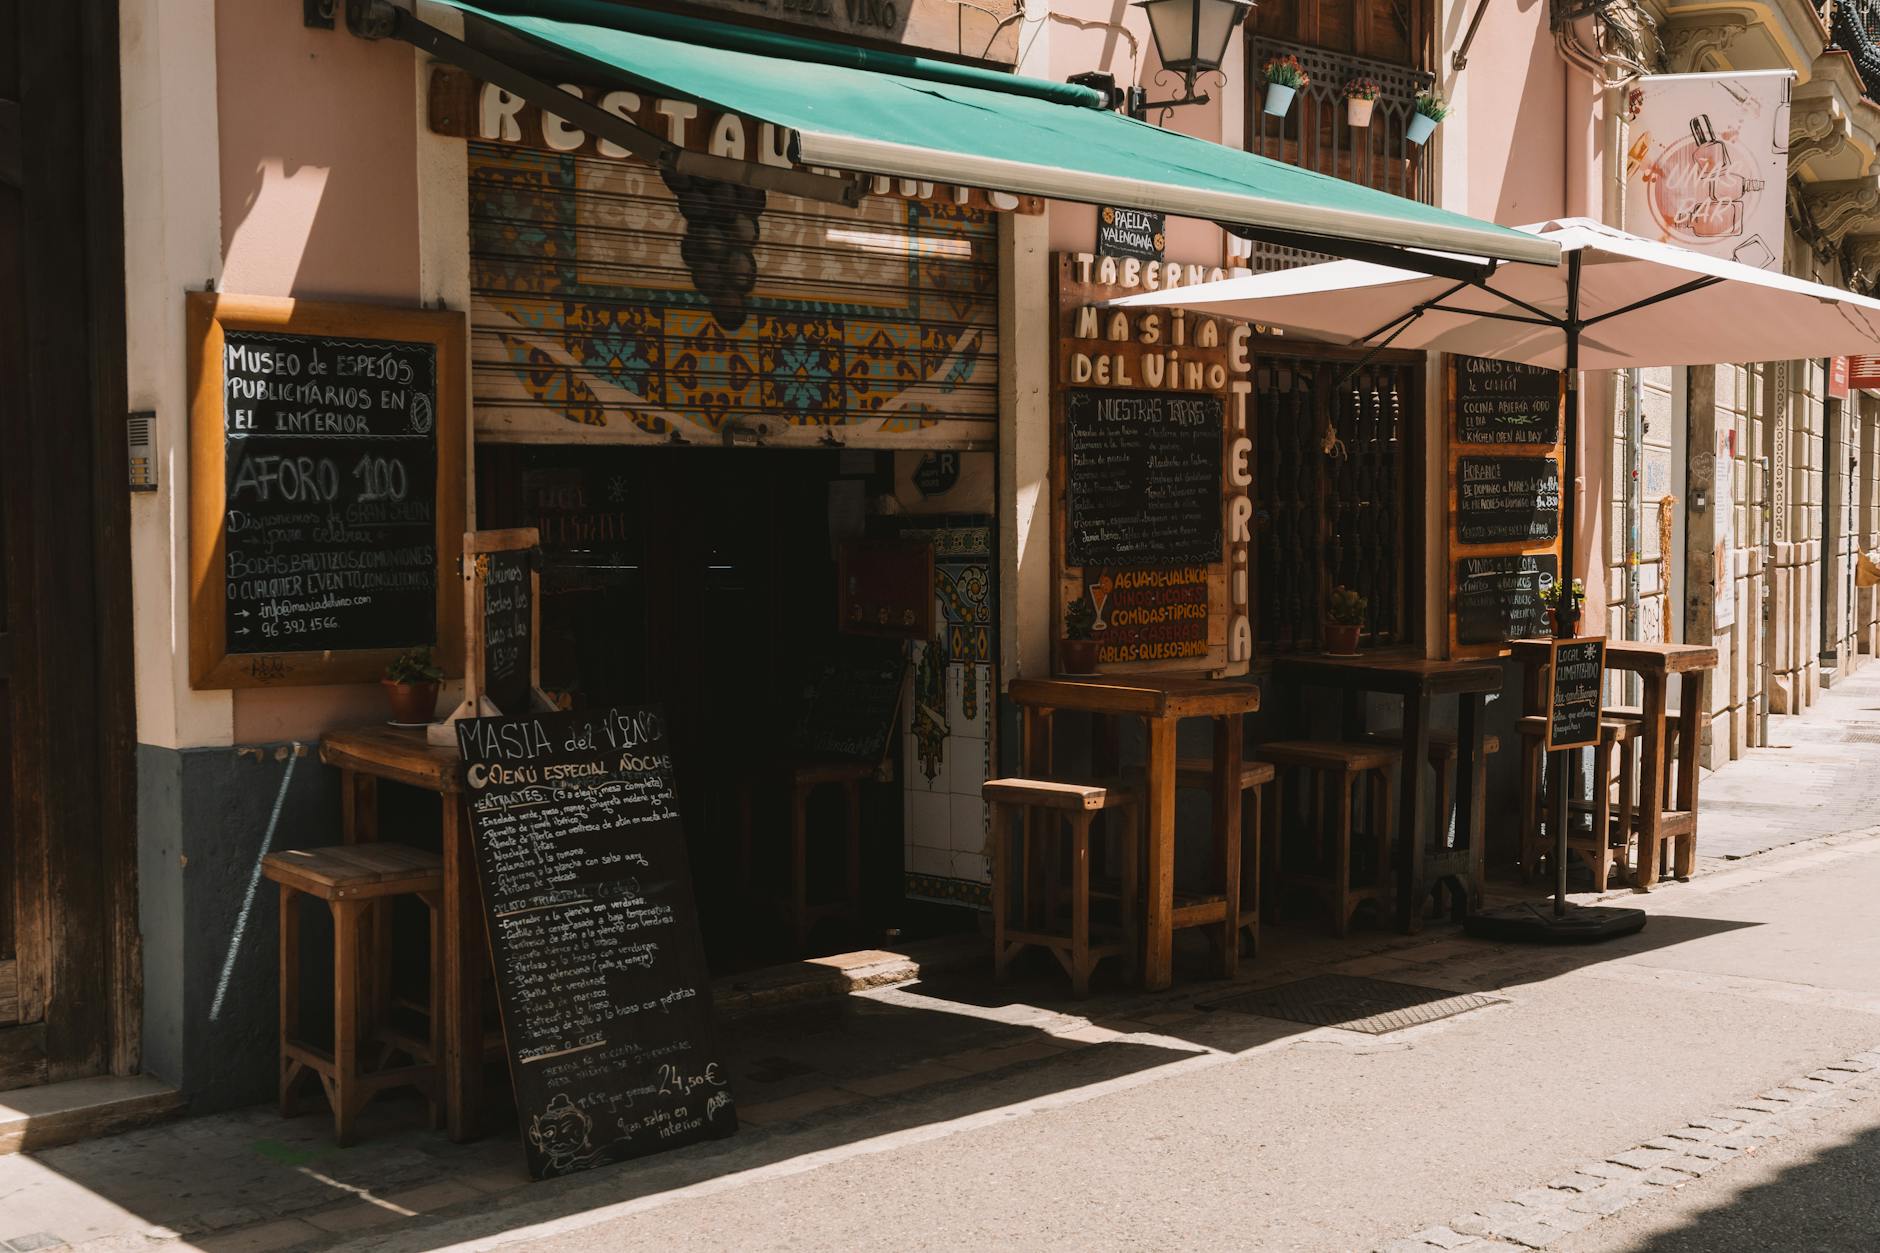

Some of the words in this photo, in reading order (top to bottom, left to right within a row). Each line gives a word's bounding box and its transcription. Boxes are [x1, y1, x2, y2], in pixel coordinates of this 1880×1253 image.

[1114, 210, 1152, 232] PAELLA
[1102, 226, 1154, 251] VALENCIANA
[228, 345, 301, 376] MUSEO
[308, 346, 329, 375] de
[336, 352, 415, 384] ESPEJOS
[1071, 353, 1133, 386] DEL
[228, 377, 371, 409] PUBLICITARIOS
[381, 389, 405, 409] EN
[1097, 398, 1162, 423] NUESTRAS
[1167, 399, 1205, 426] TAPAS
[1464, 401, 1494, 413] COCINA
[235, 409, 258, 430] EL
[274, 408, 370, 433] INTERIOR
[231, 456, 338, 503] AFORO
[352, 452, 407, 503] 100
[1474, 483, 1501, 495] DOMINGO
[1468, 559, 1492, 574] VINOS
[261, 621, 280, 637] 96
[283, 618, 308, 634] 392
[1558, 648, 1580, 663] LOCAL
[1557, 662, 1599, 681] CLIMATIZADO
[459, 720, 553, 761] MASIA
[565, 722, 597, 752] del
[544, 761, 609, 780] ESPECIAL
[585, 858, 599, 866] con
[593, 904, 607, 912] con
[515, 974, 544, 988] Paella
[518, 989, 547, 1003] Paella
[552, 982, 562, 992] de
[643, 1000, 657, 1010] con
[660, 988, 696, 1015] patatas
[658, 1062, 728, 1096] 24,50€
[643, 1110, 671, 1126] salón
[674, 1107, 688, 1118] en
[659, 1117, 703, 1138] interior
